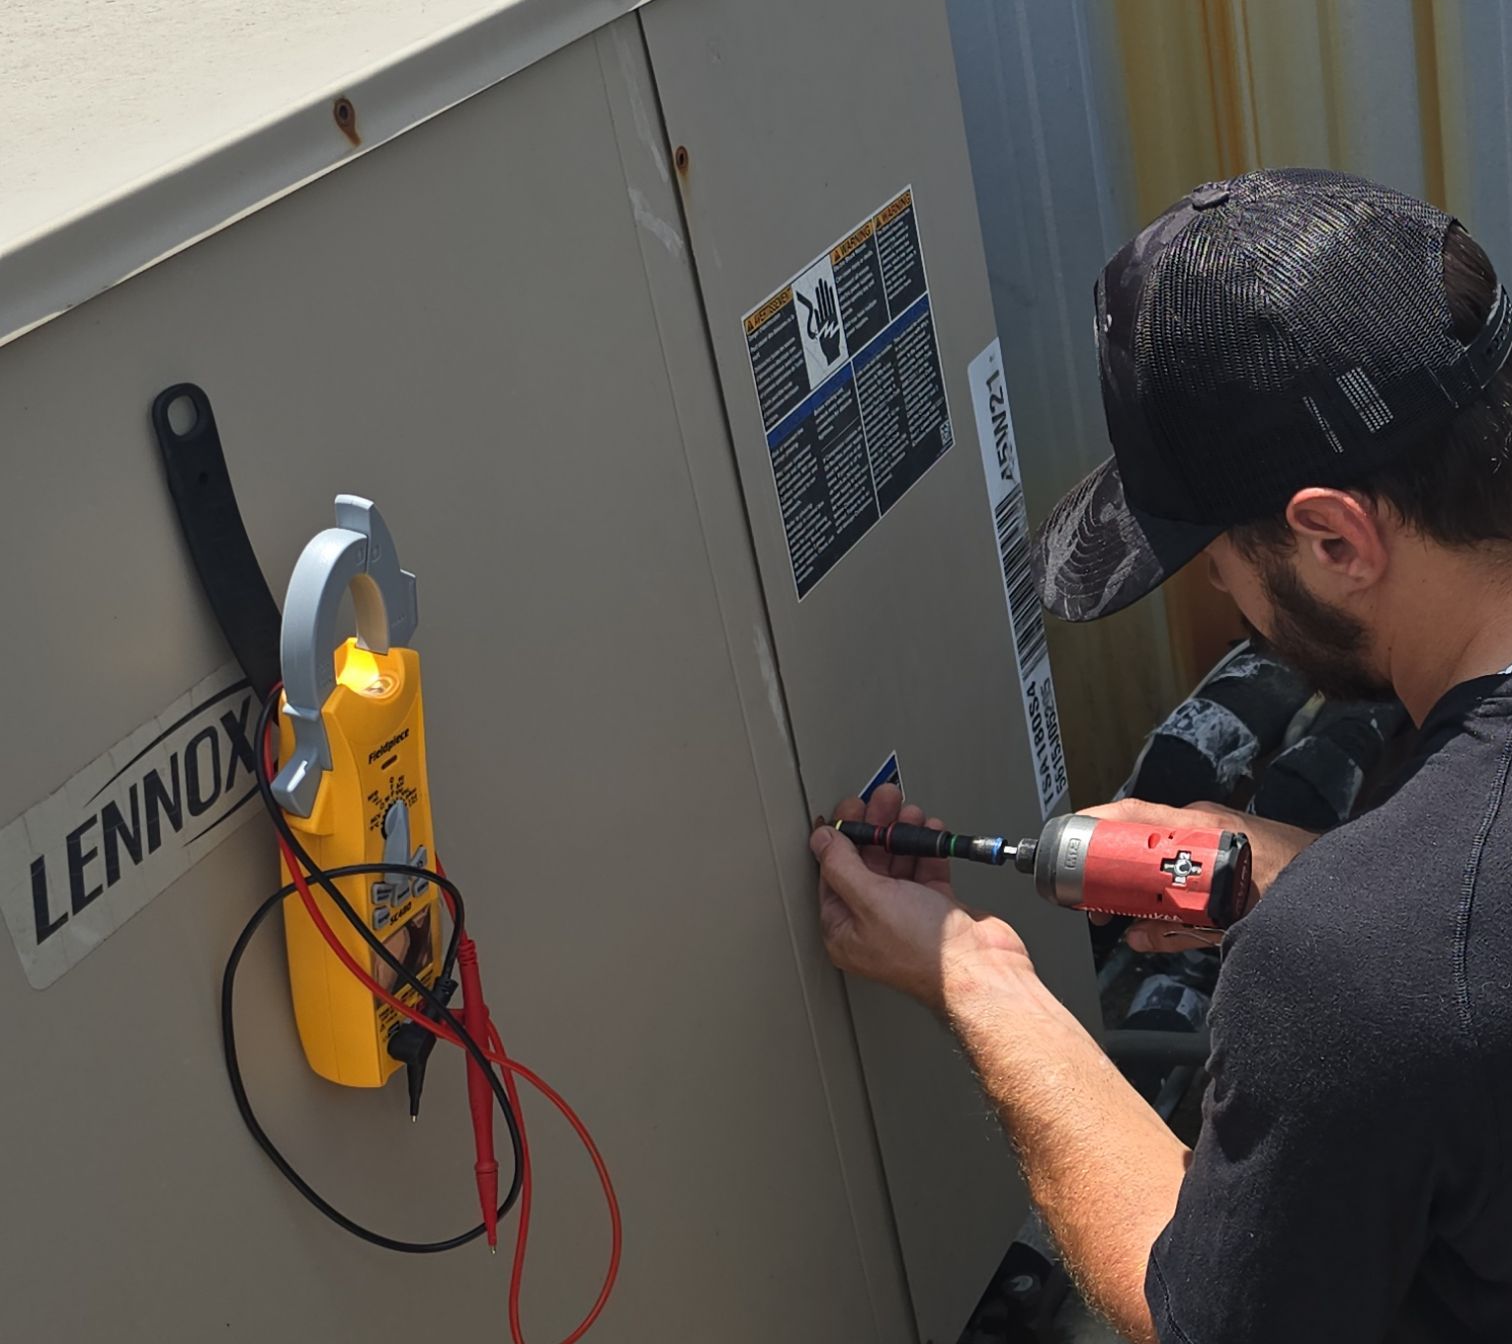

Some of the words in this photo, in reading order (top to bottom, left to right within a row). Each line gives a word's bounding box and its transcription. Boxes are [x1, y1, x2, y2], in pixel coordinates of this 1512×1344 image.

[839, 224, 872, 256] WARNING
[881, 191, 912, 221] WARNING
[1026, 681, 1053, 811] TSA180S4
[30, 694, 255, 945] LENNOX
